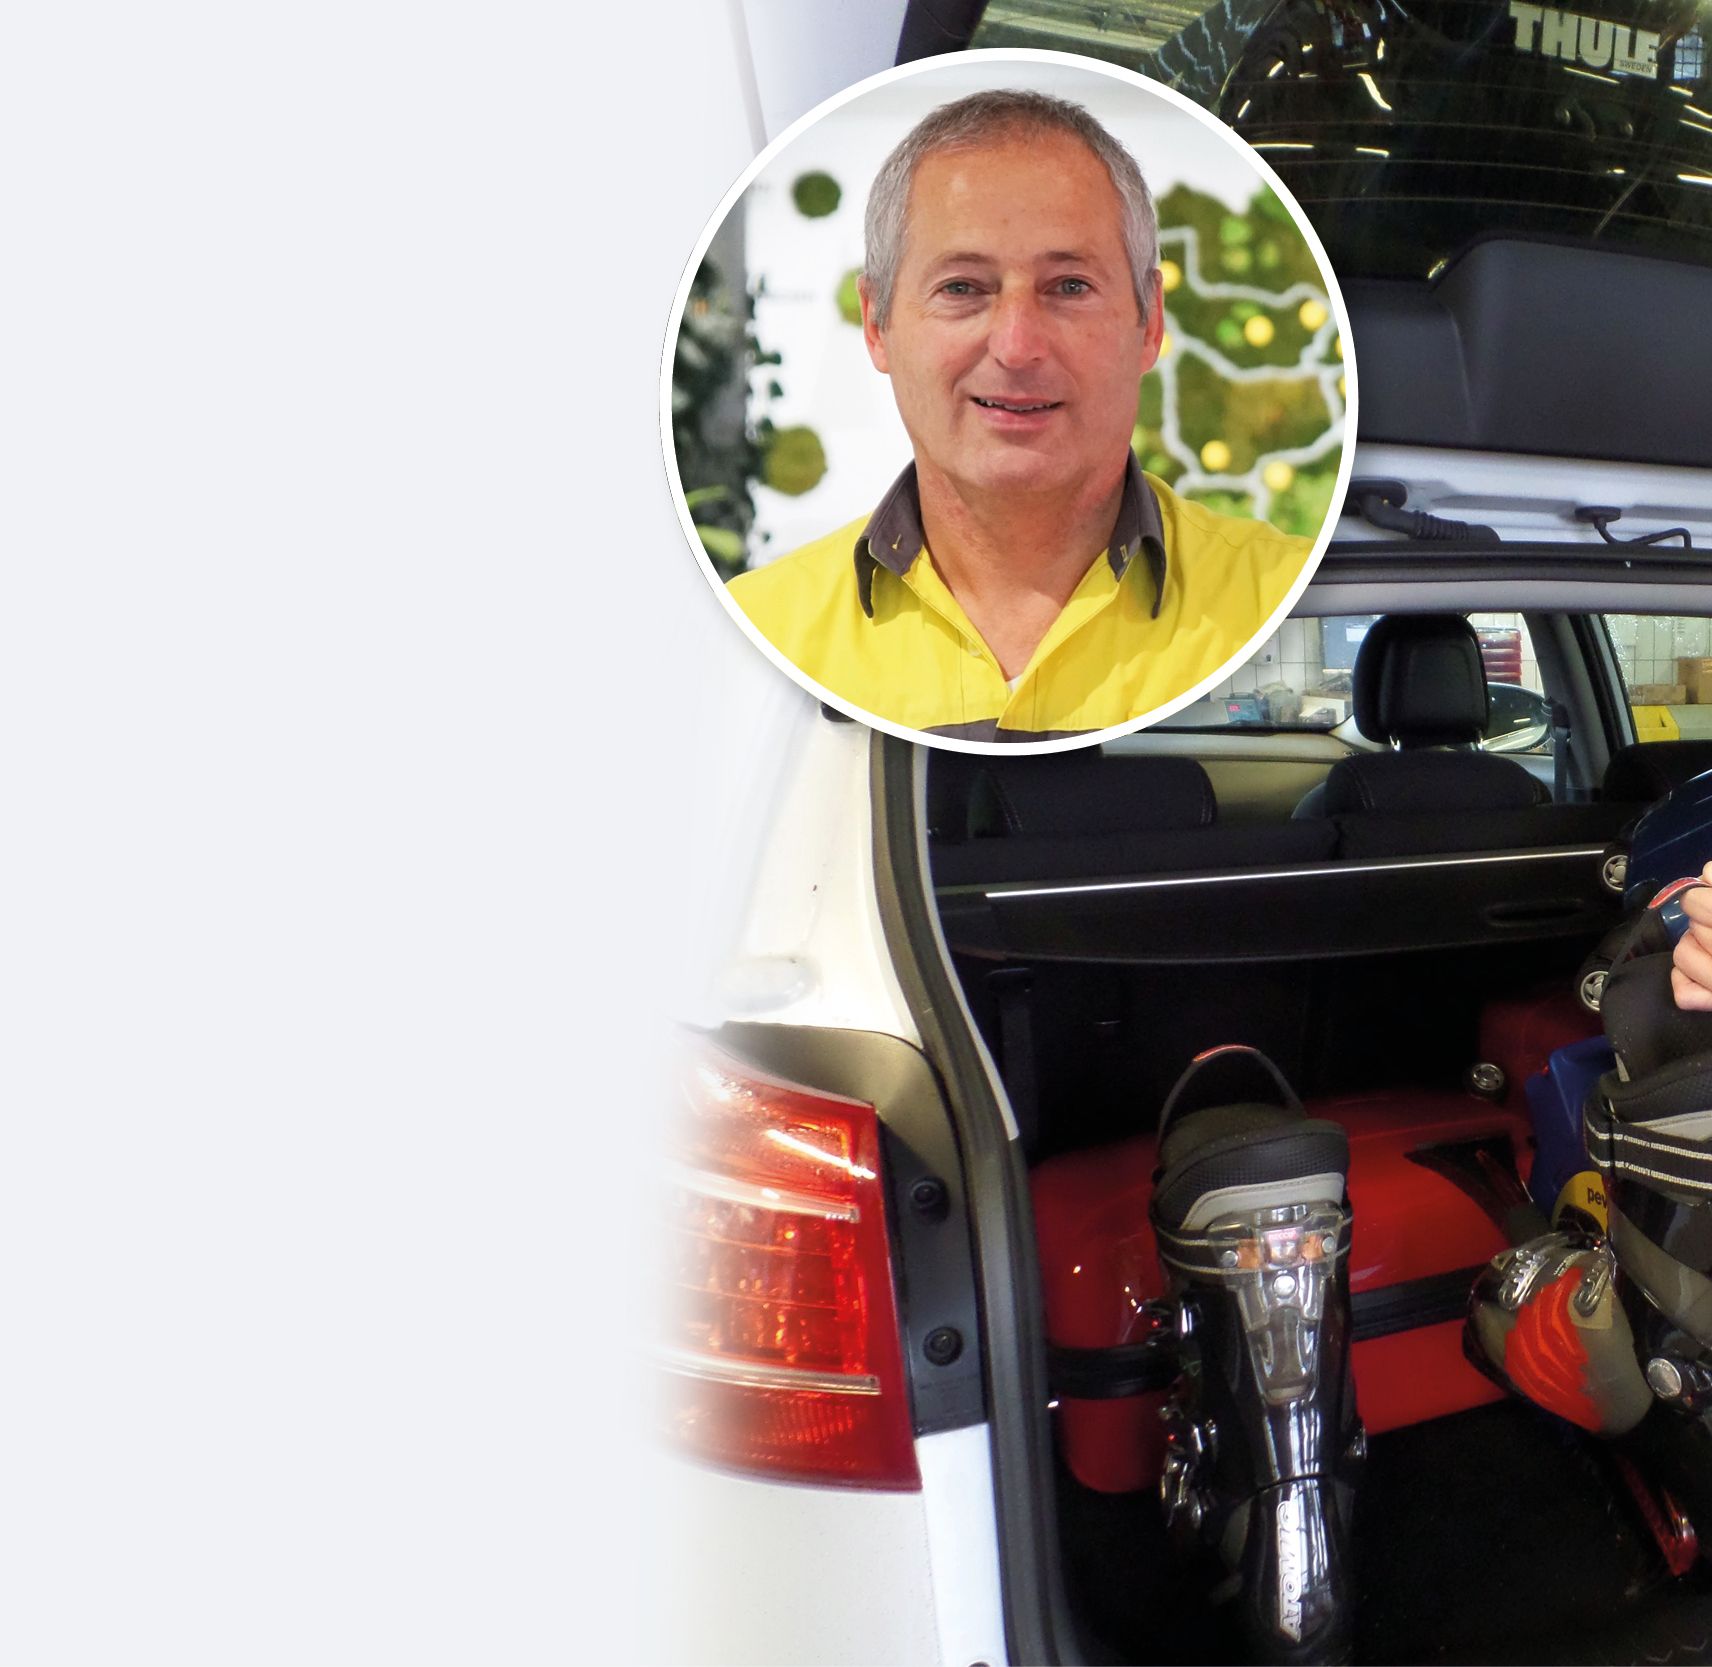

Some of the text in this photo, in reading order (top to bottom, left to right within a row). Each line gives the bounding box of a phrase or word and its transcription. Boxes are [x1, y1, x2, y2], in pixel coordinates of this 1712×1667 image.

[1509, 1, 1661, 79] THULE
[1618, 59, 1652, 73] SWEDEN
[1275, 1501, 1302, 1643] ATOMIC
